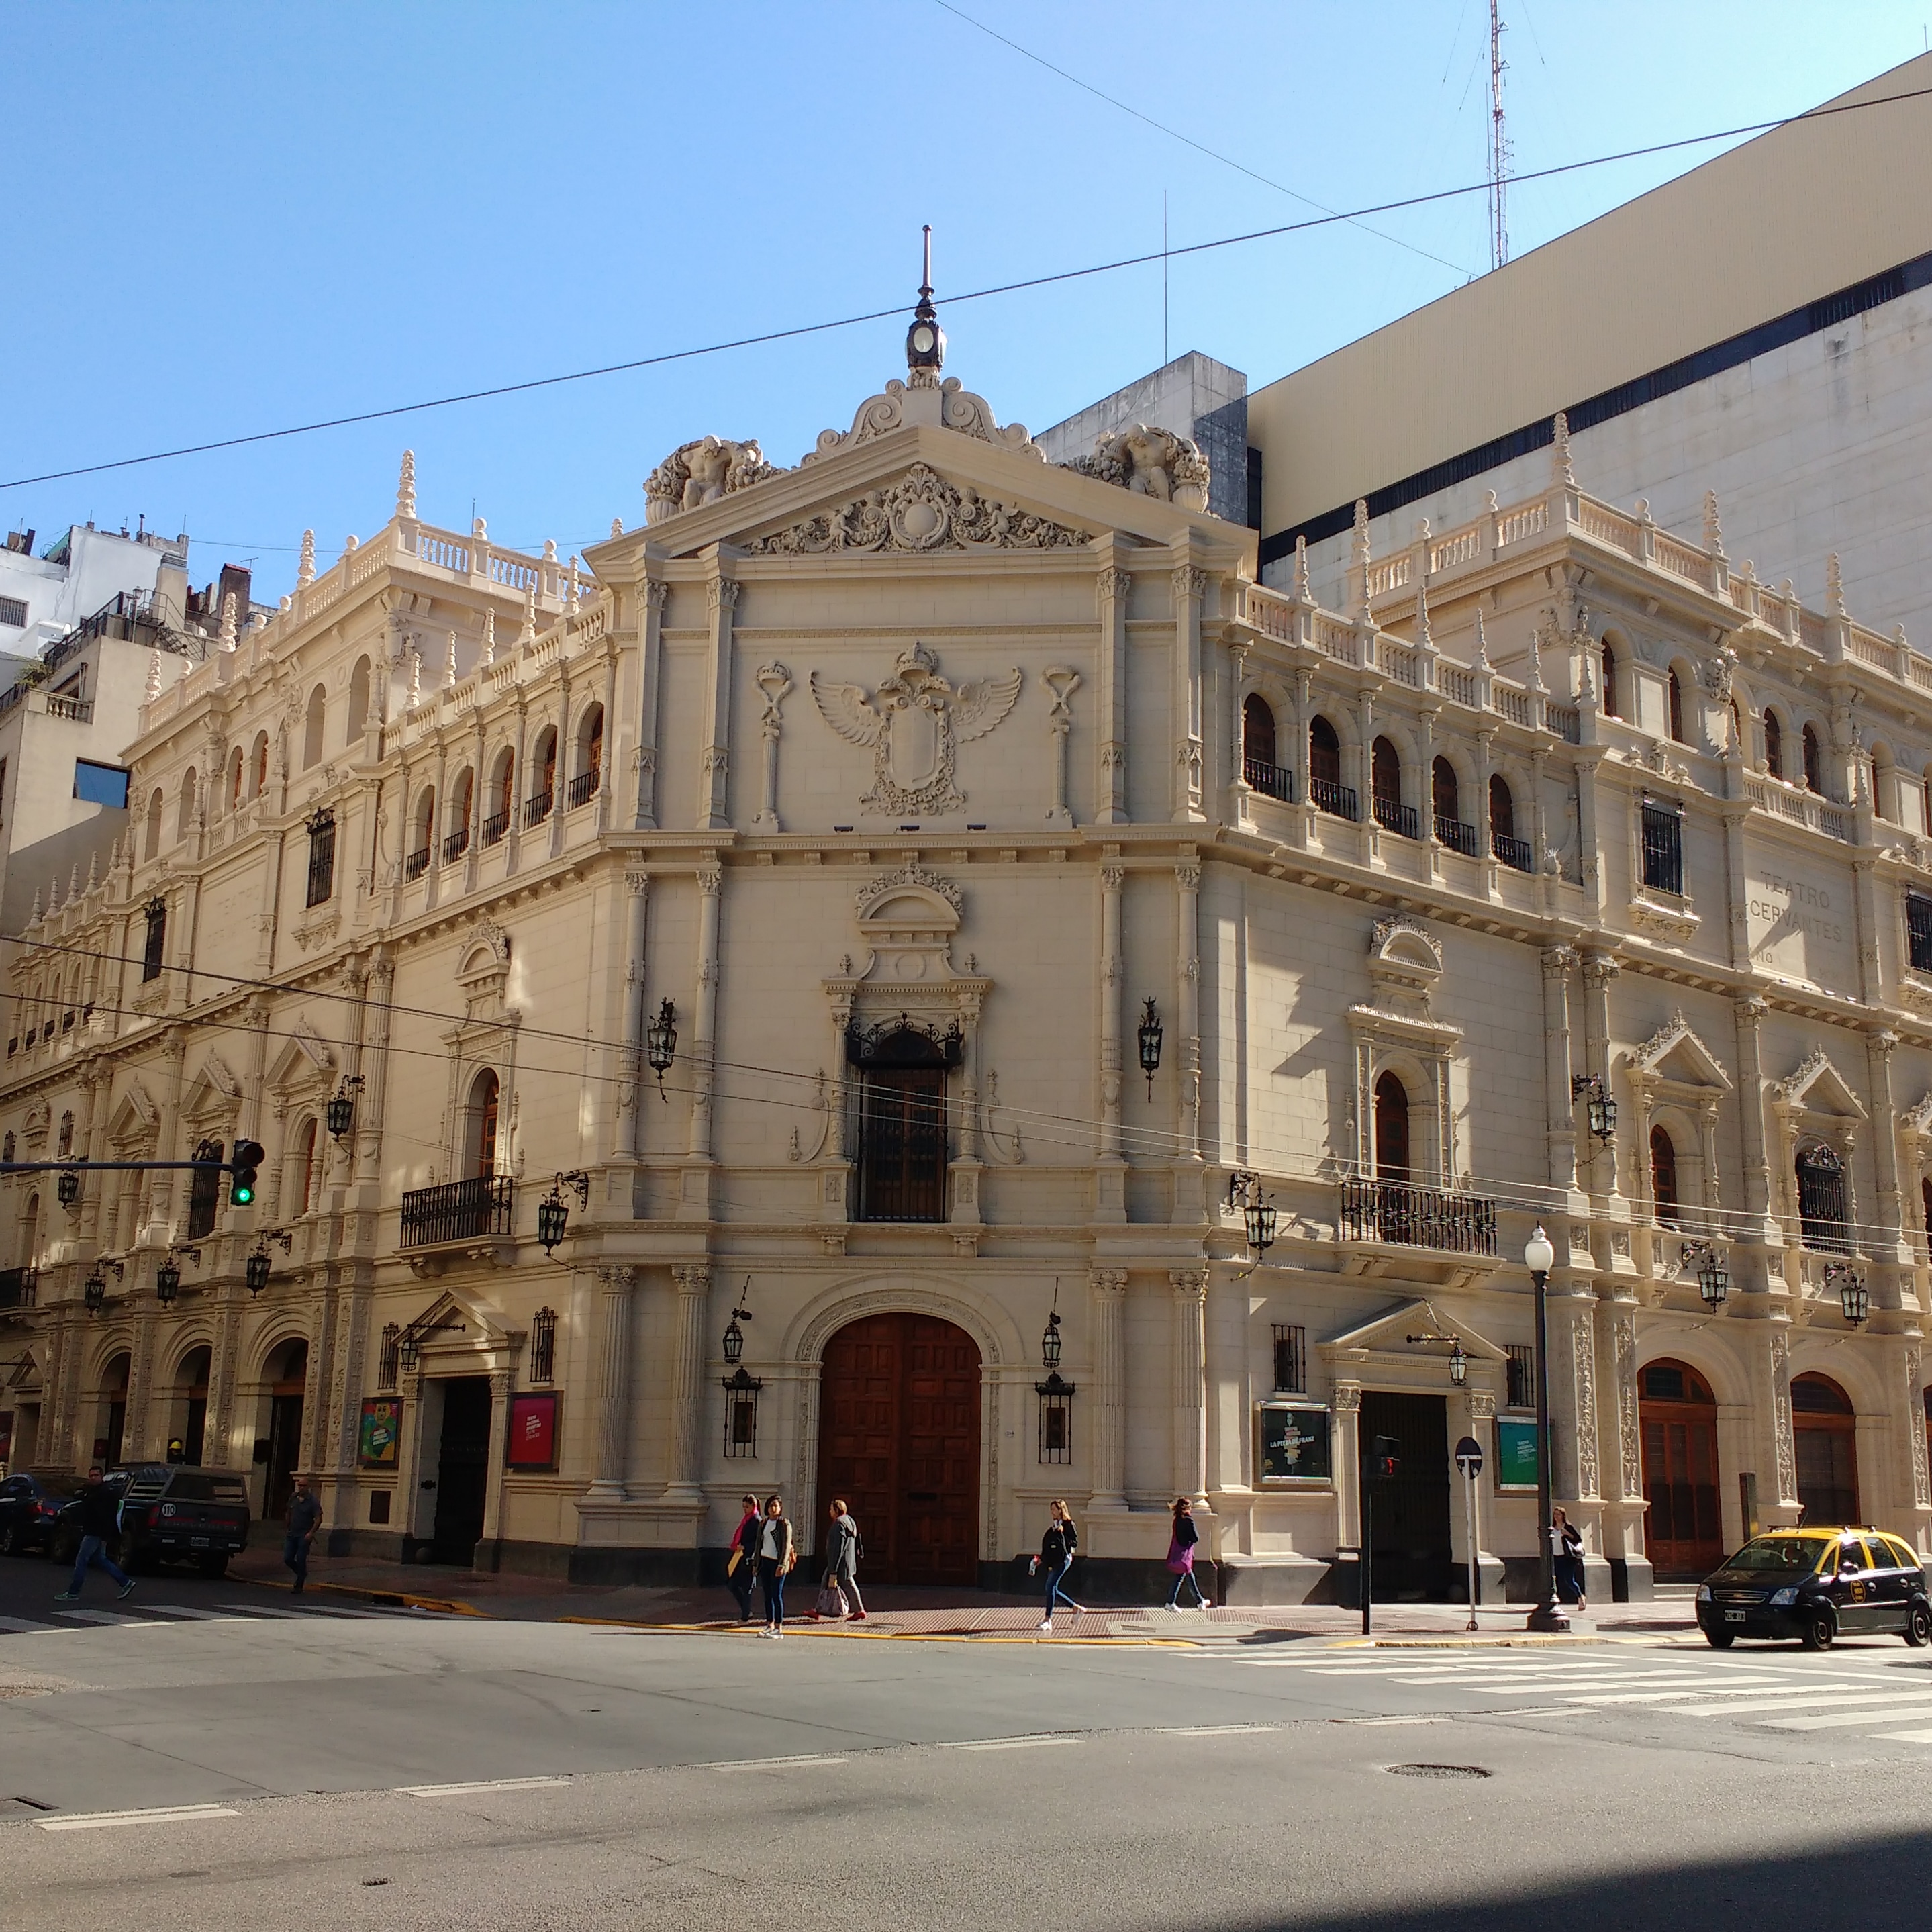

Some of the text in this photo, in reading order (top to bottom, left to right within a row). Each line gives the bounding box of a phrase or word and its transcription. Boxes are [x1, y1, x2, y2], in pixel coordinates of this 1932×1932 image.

[1760, 871, 1829, 908] TEATRO
[1750, 900, 1841, 942] CERVANTES
[164, 1505, 175, 1515] 110
